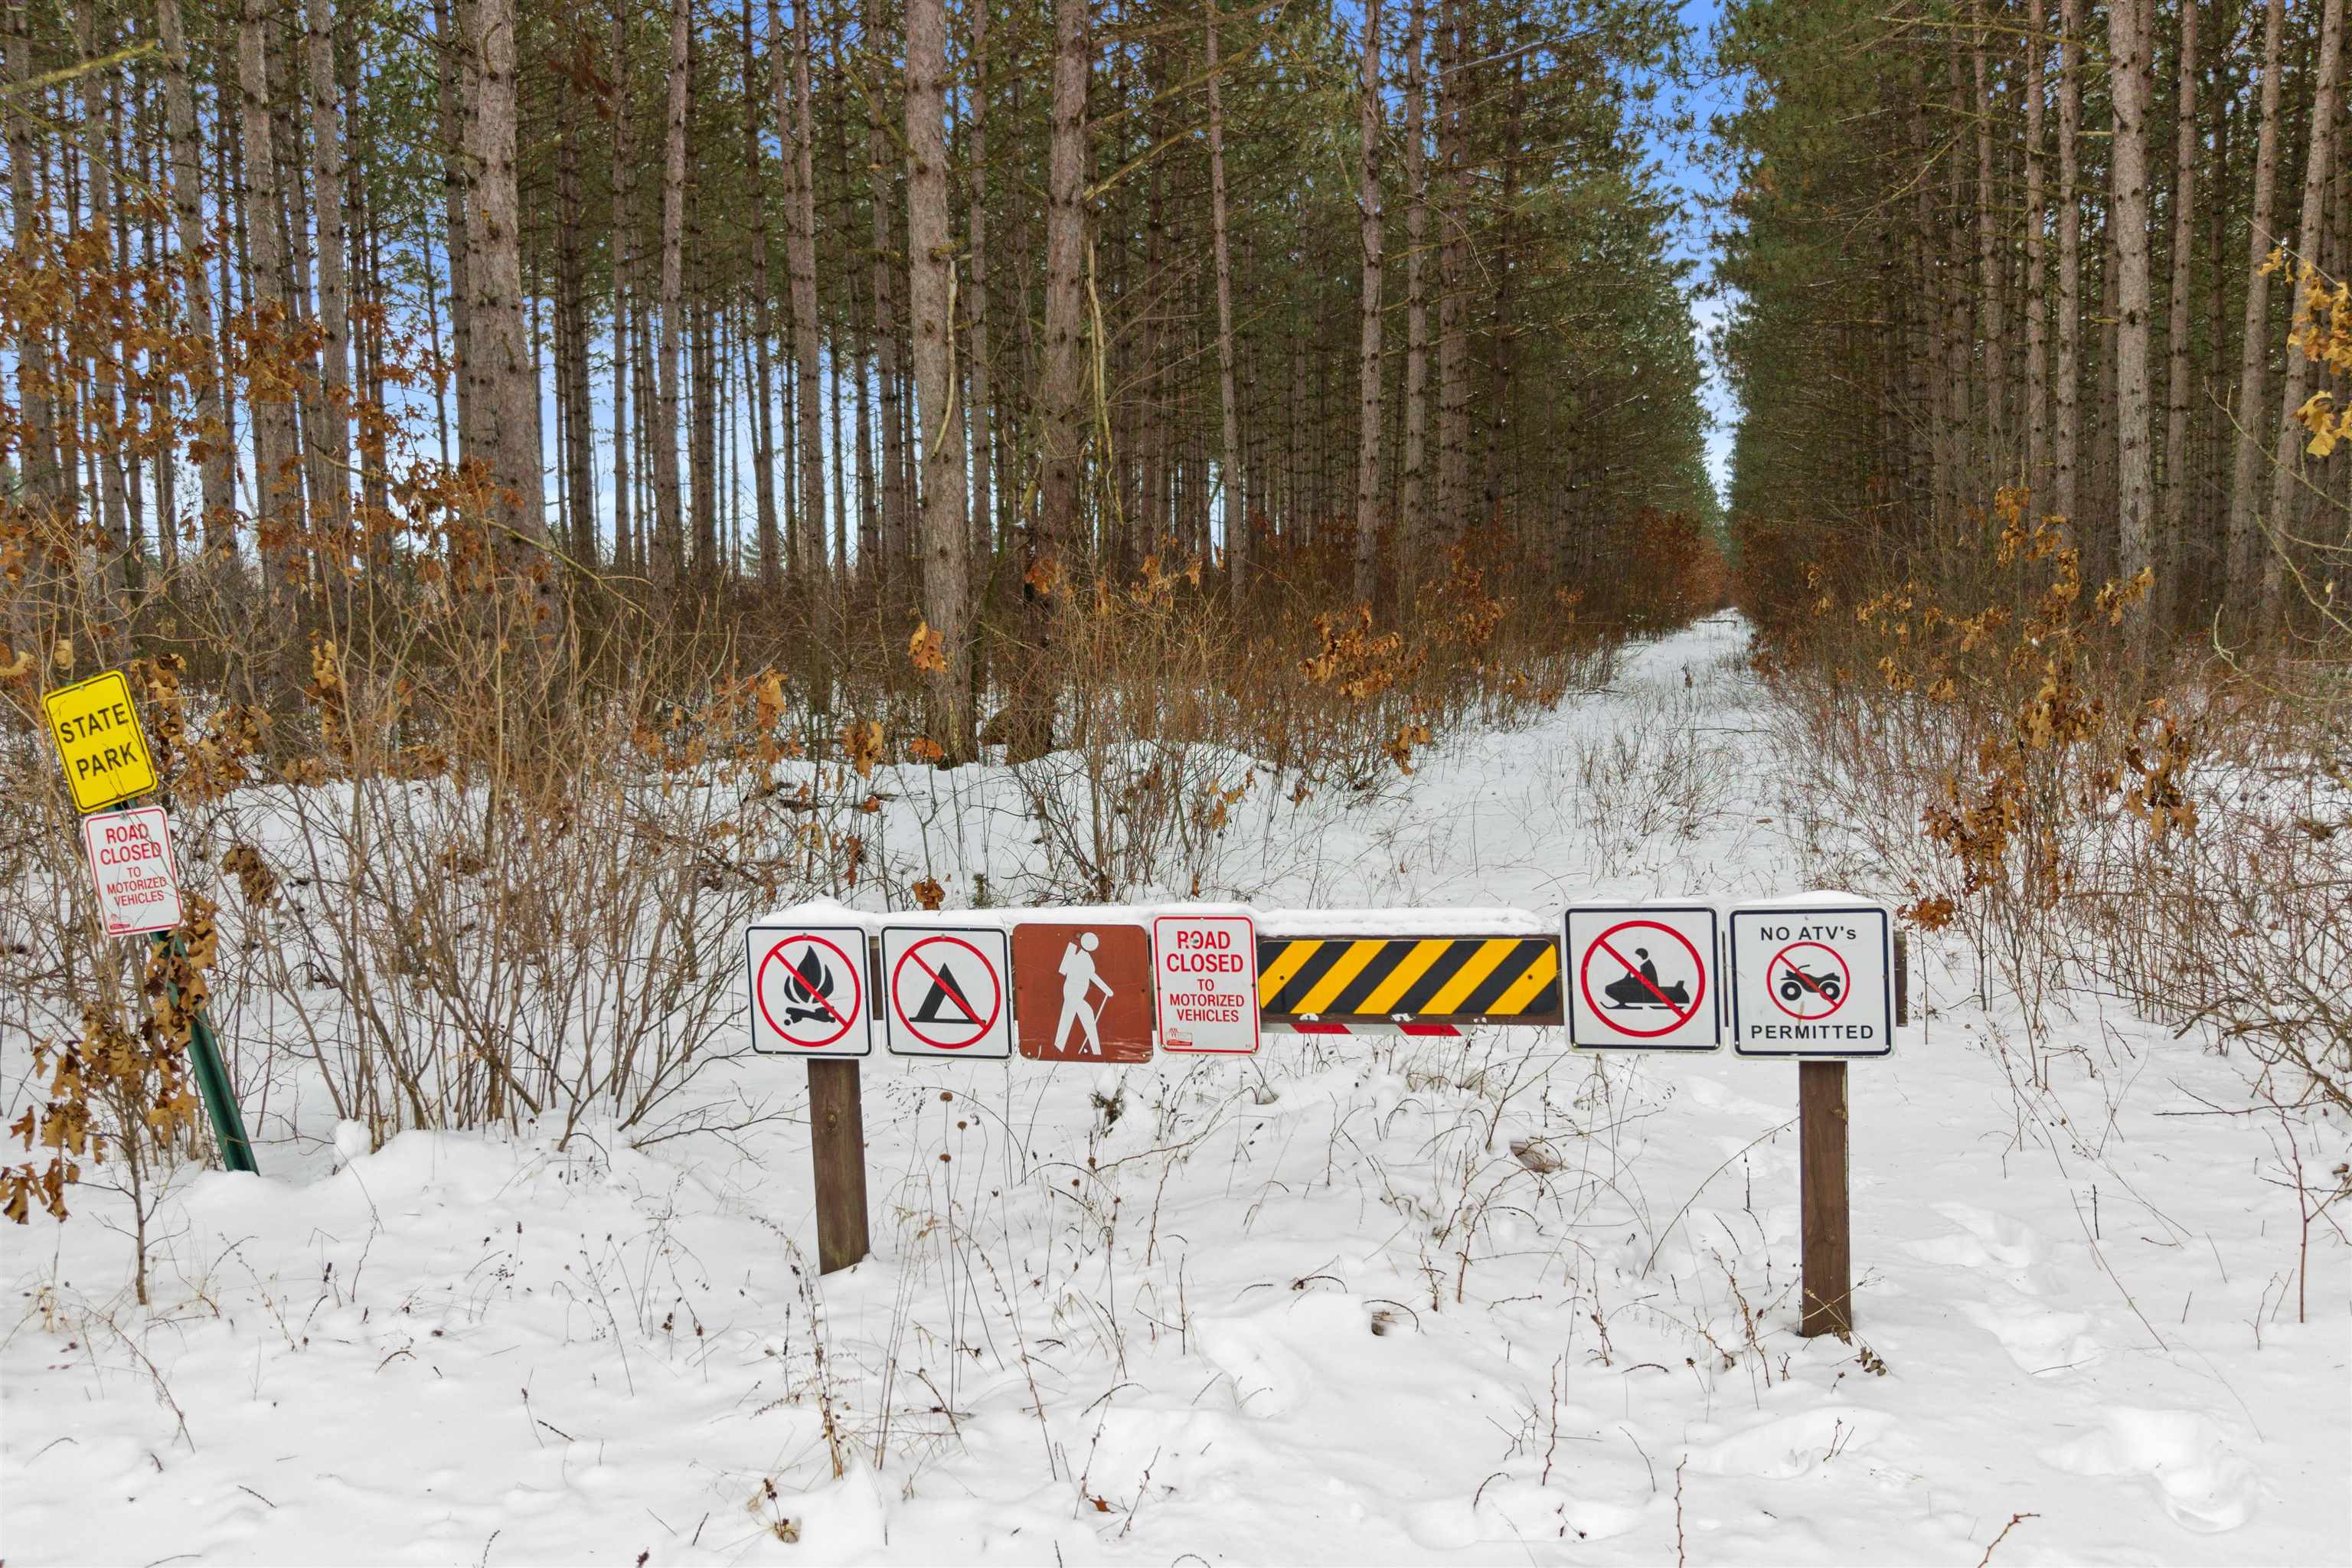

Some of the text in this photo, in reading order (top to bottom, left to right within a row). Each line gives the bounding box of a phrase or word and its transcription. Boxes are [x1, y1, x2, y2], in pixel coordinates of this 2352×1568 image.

[60, 703, 129, 743] STATE
[76, 741, 138, 780] PARK
[106, 823, 149, 844] ROAD
[100, 842, 162, 865] CLOSED
[127, 866, 141, 878] TO
[106, 876, 167, 894] MOTORIZED
[114, 890, 165, 906] VEHICLES
[1177, 931, 1230, 949] ROAD
[1761, 926, 1857, 940] NO ATV's
[1167, 953, 1243, 972] CLOSED
[1197, 978, 1214, 991] TO
[1170, 993, 1244, 1007] MOTORIZED
[1177, 1009, 1239, 1022] VEHICLES
[1751, 1025, 1873, 1039] PERMITTED
